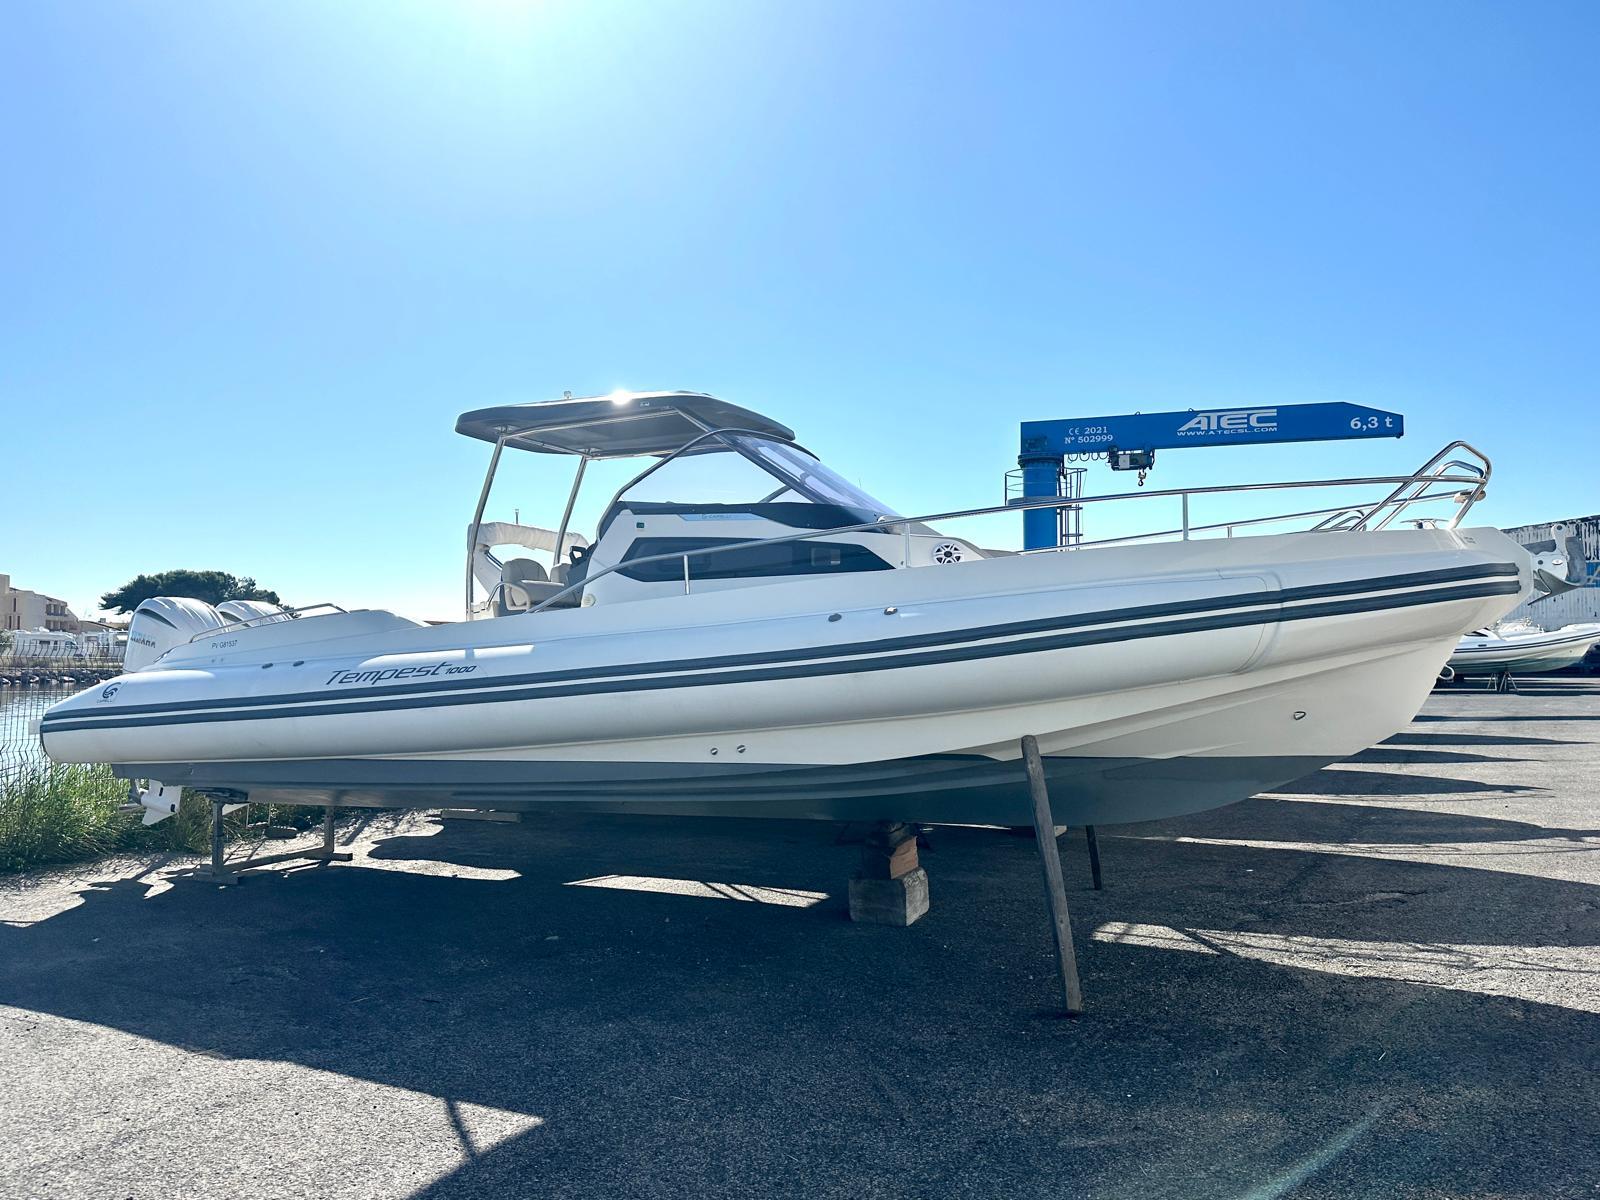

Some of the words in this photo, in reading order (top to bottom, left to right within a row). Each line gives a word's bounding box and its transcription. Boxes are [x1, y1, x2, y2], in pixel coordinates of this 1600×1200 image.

[1177, 408, 1278, 432] ATEC
[1350, 416, 1379, 432] 6,3
[1384, 416, 1393, 428] t
[1084, 426, 1107, 435] 2021
[1077, 434, 1113, 444] 502999
[326, 661, 452, 685] Tempest
[445, 665, 477, 675] 1000
